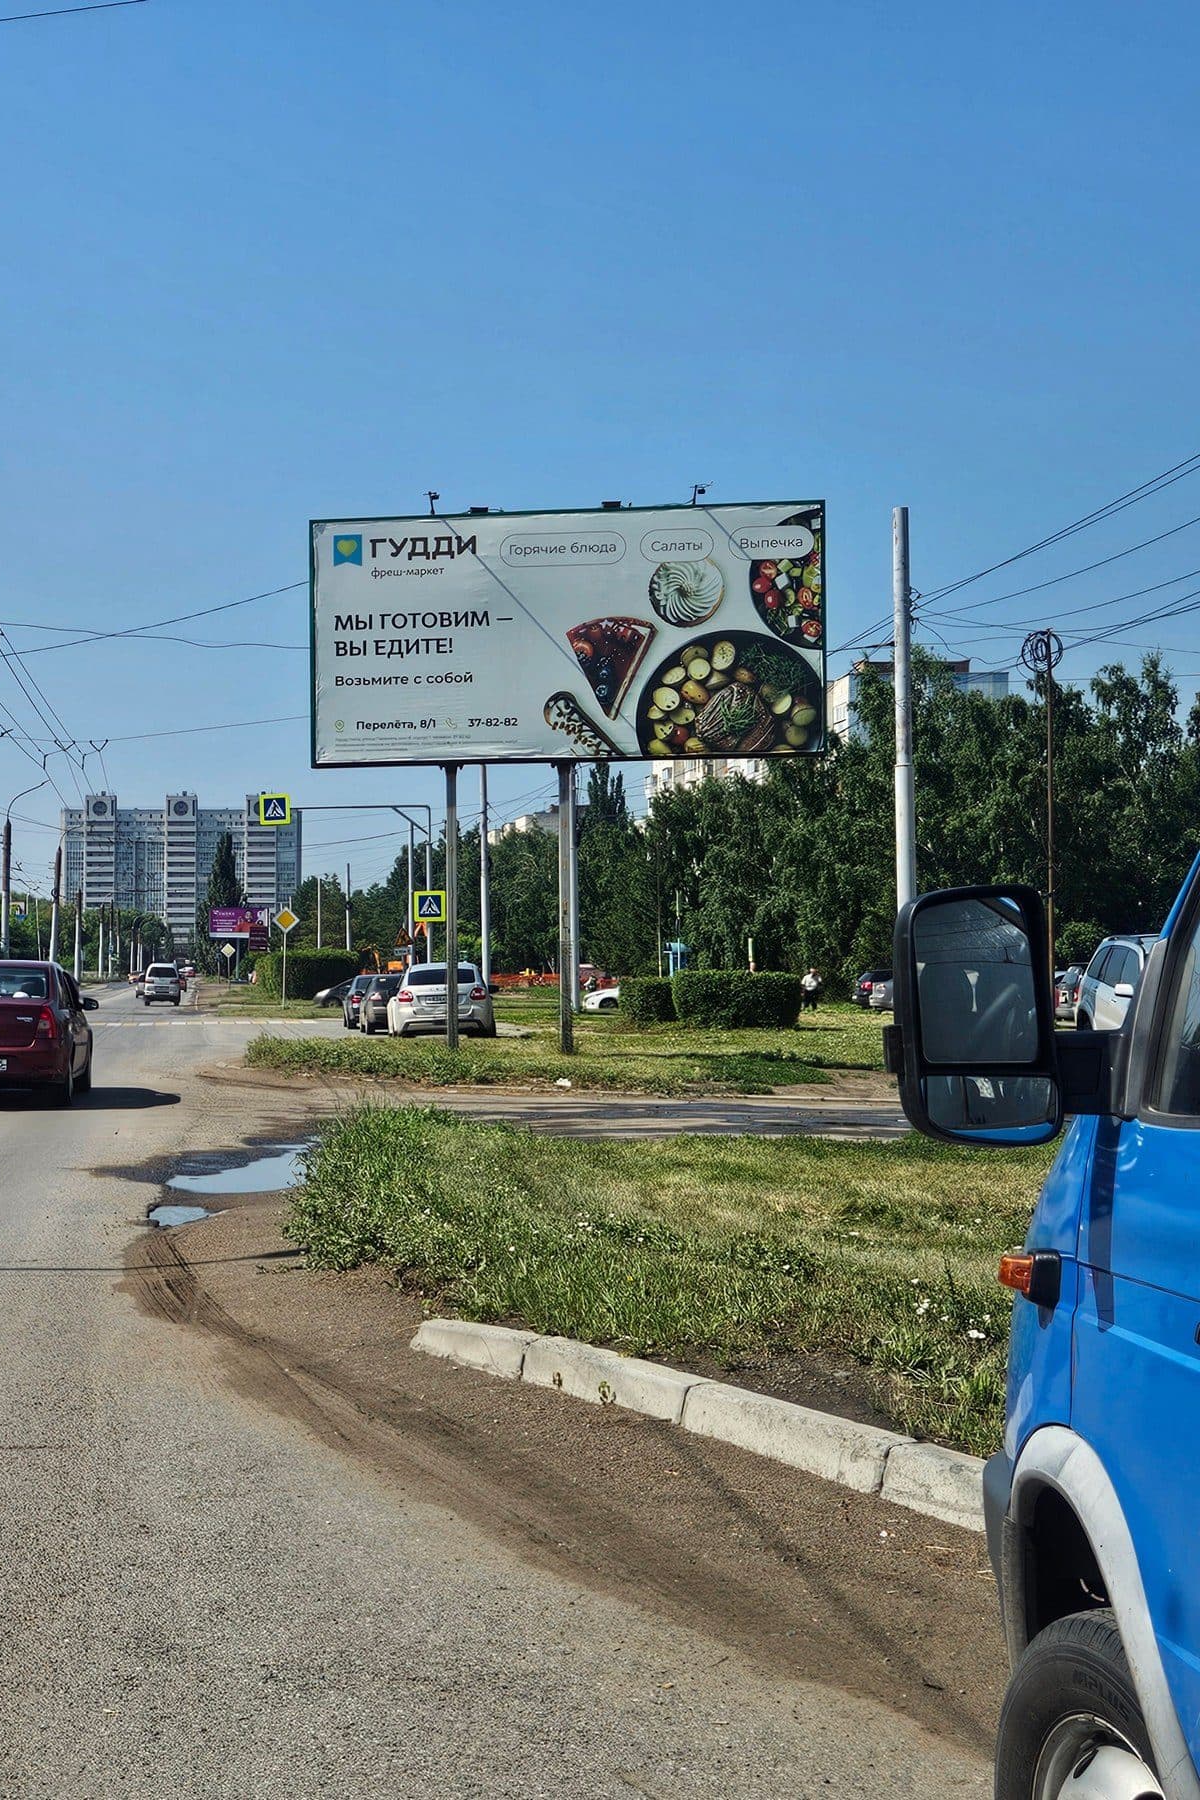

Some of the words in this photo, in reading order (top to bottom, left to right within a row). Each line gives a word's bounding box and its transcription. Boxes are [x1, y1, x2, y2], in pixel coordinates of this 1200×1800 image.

[369, 534, 477, 561] ГУДДИ
[509, 544, 566, 557] Горячие
[570, 541, 617, 554] блюда
[650, 540, 703, 552] Салаты
[739, 537, 803, 549] Выпечка
[371, 566, 445, 579] фреш-маркет
[334, 613, 373, 631] МЫ
[379, 610, 491, 630] ГОТОВИМ
[334, 639, 367, 657] ВЫ
[373, 637, 454, 659] ЕДИТЕ!
[335, 674, 409, 687] Возьмите
[413, 674, 422, 684] с
[426, 671, 473, 684] собой
[356, 719, 417, 732] Перелёта,
[419, 718, 437, 730] 8/1
[468, 717, 518, 728] 37-82-82
